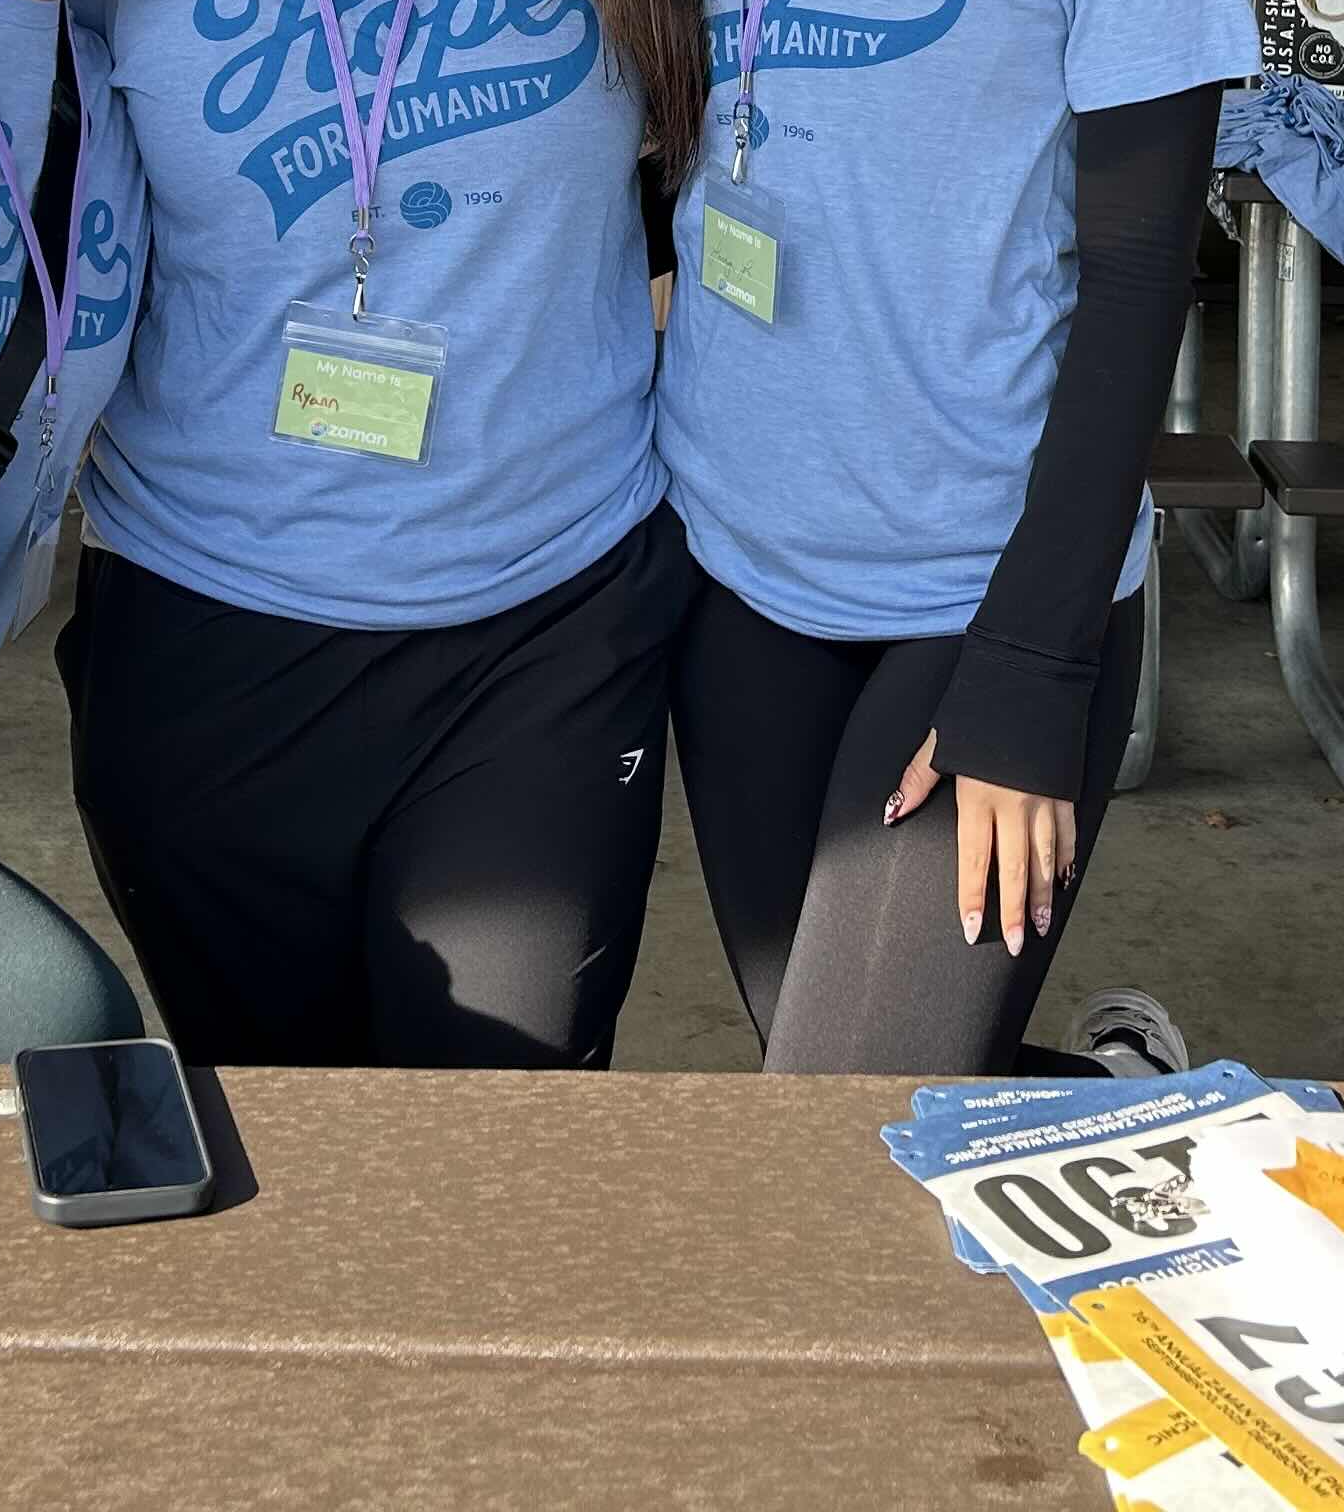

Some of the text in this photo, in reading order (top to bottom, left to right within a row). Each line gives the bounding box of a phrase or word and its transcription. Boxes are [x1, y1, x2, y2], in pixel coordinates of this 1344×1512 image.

[725, 20, 888, 63] HMANITY
[1263, 37, 1277, 56] OF
[1316, 44, 1331, 54] NO
[270, 73, 554, 196] FOR UMANITY
[716, 114, 815, 141] ES 1996
[351, 190, 503, 223] ET. 1996
[316, 359, 339, 377] My
[341, 364, 387, 384] Name
[327, 423, 388, 448] zaman
[1045, 1126, 1081, 1145] RUN
[1078, 1115, 1137, 1139] ZAMAN
[944, 1141, 1003, 1166] PICNIC
[1002, 1132, 1047, 1154] WALK
